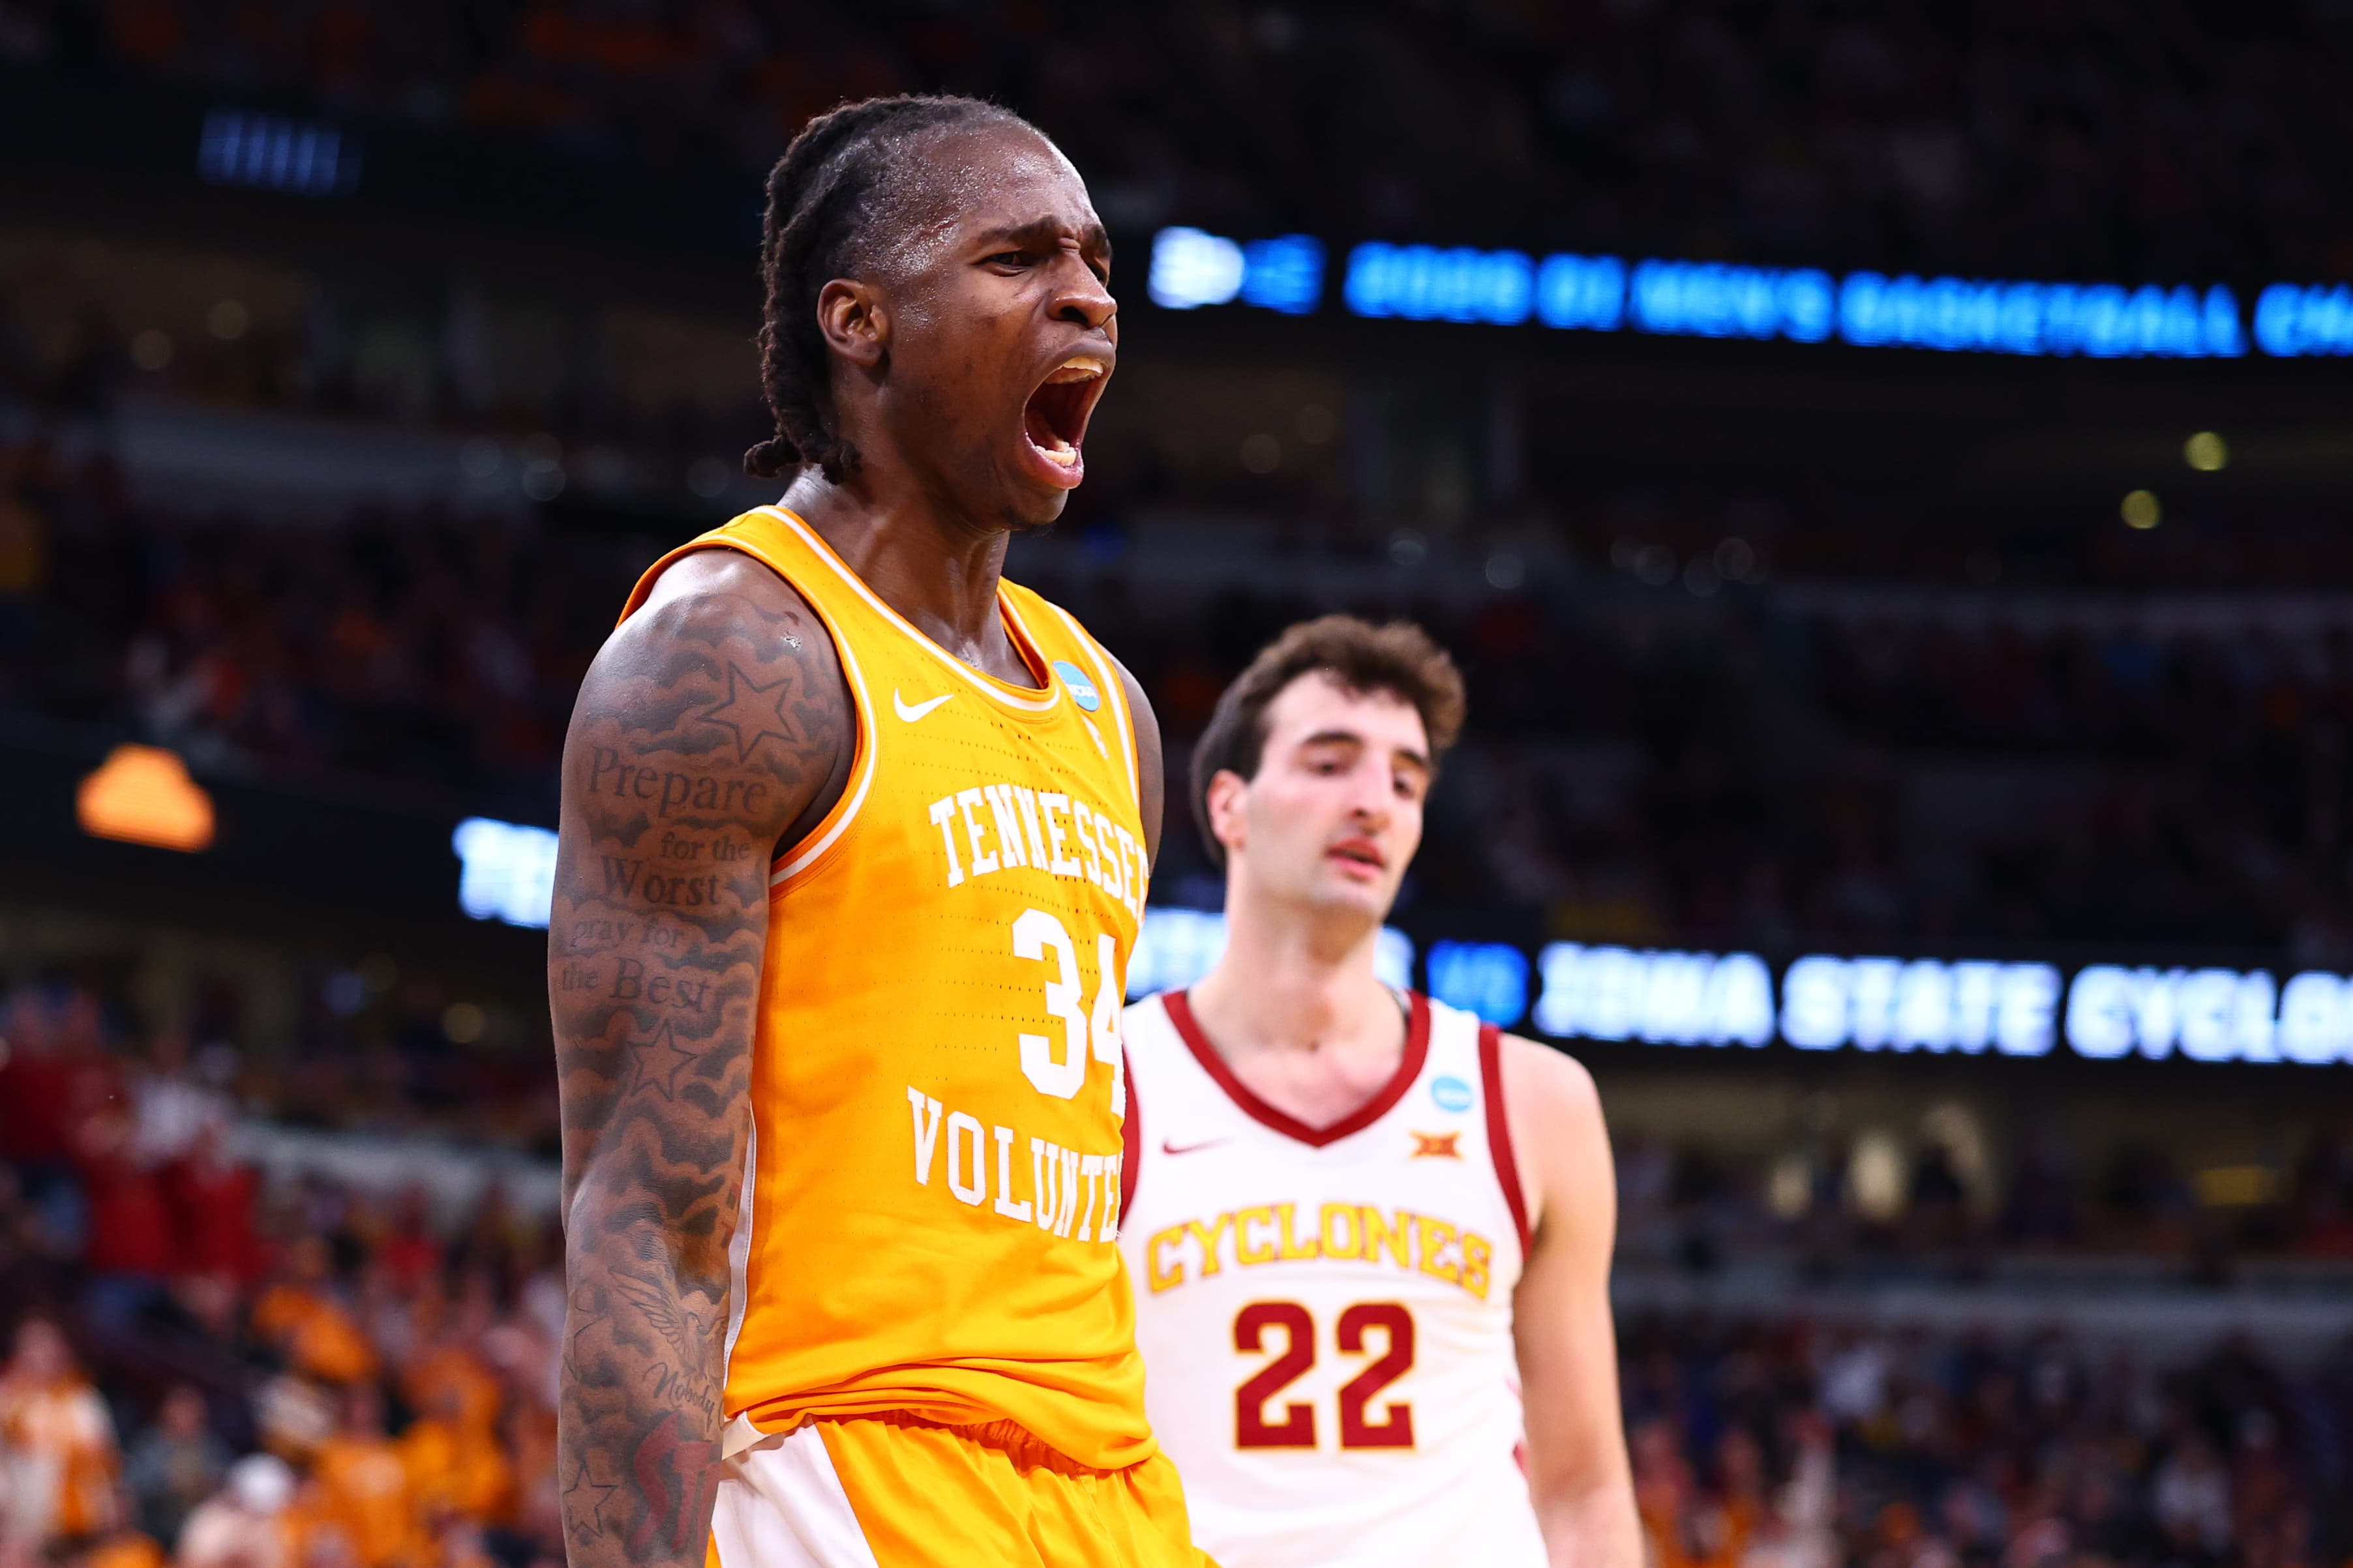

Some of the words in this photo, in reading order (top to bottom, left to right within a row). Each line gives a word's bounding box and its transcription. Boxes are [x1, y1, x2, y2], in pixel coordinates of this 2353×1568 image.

[1836, 270, 2251, 357] BASKETBALL
[589, 746, 770, 818] Prepare
[599, 855, 721, 907] Worst
[660, 831, 701, 861] for
[712, 833, 750, 861] the
[570, 917, 633, 948] pray
[642, 916, 684, 949] for
[562, 961, 598, 991] the
[609, 956, 710, 1014] Best
[1012, 908, 1126, 1118] 34
[1778, 954, 2063, 1057] STATE
[2064, 964, 2353, 1065] CYCLO
[907, 1084, 1123, 1243] VOLUNTE
[1146, 1202, 1492, 1301] CYCLONES
[643, 1362, 714, 1433] Nobody
[1233, 1301, 1416, 1451] 22
